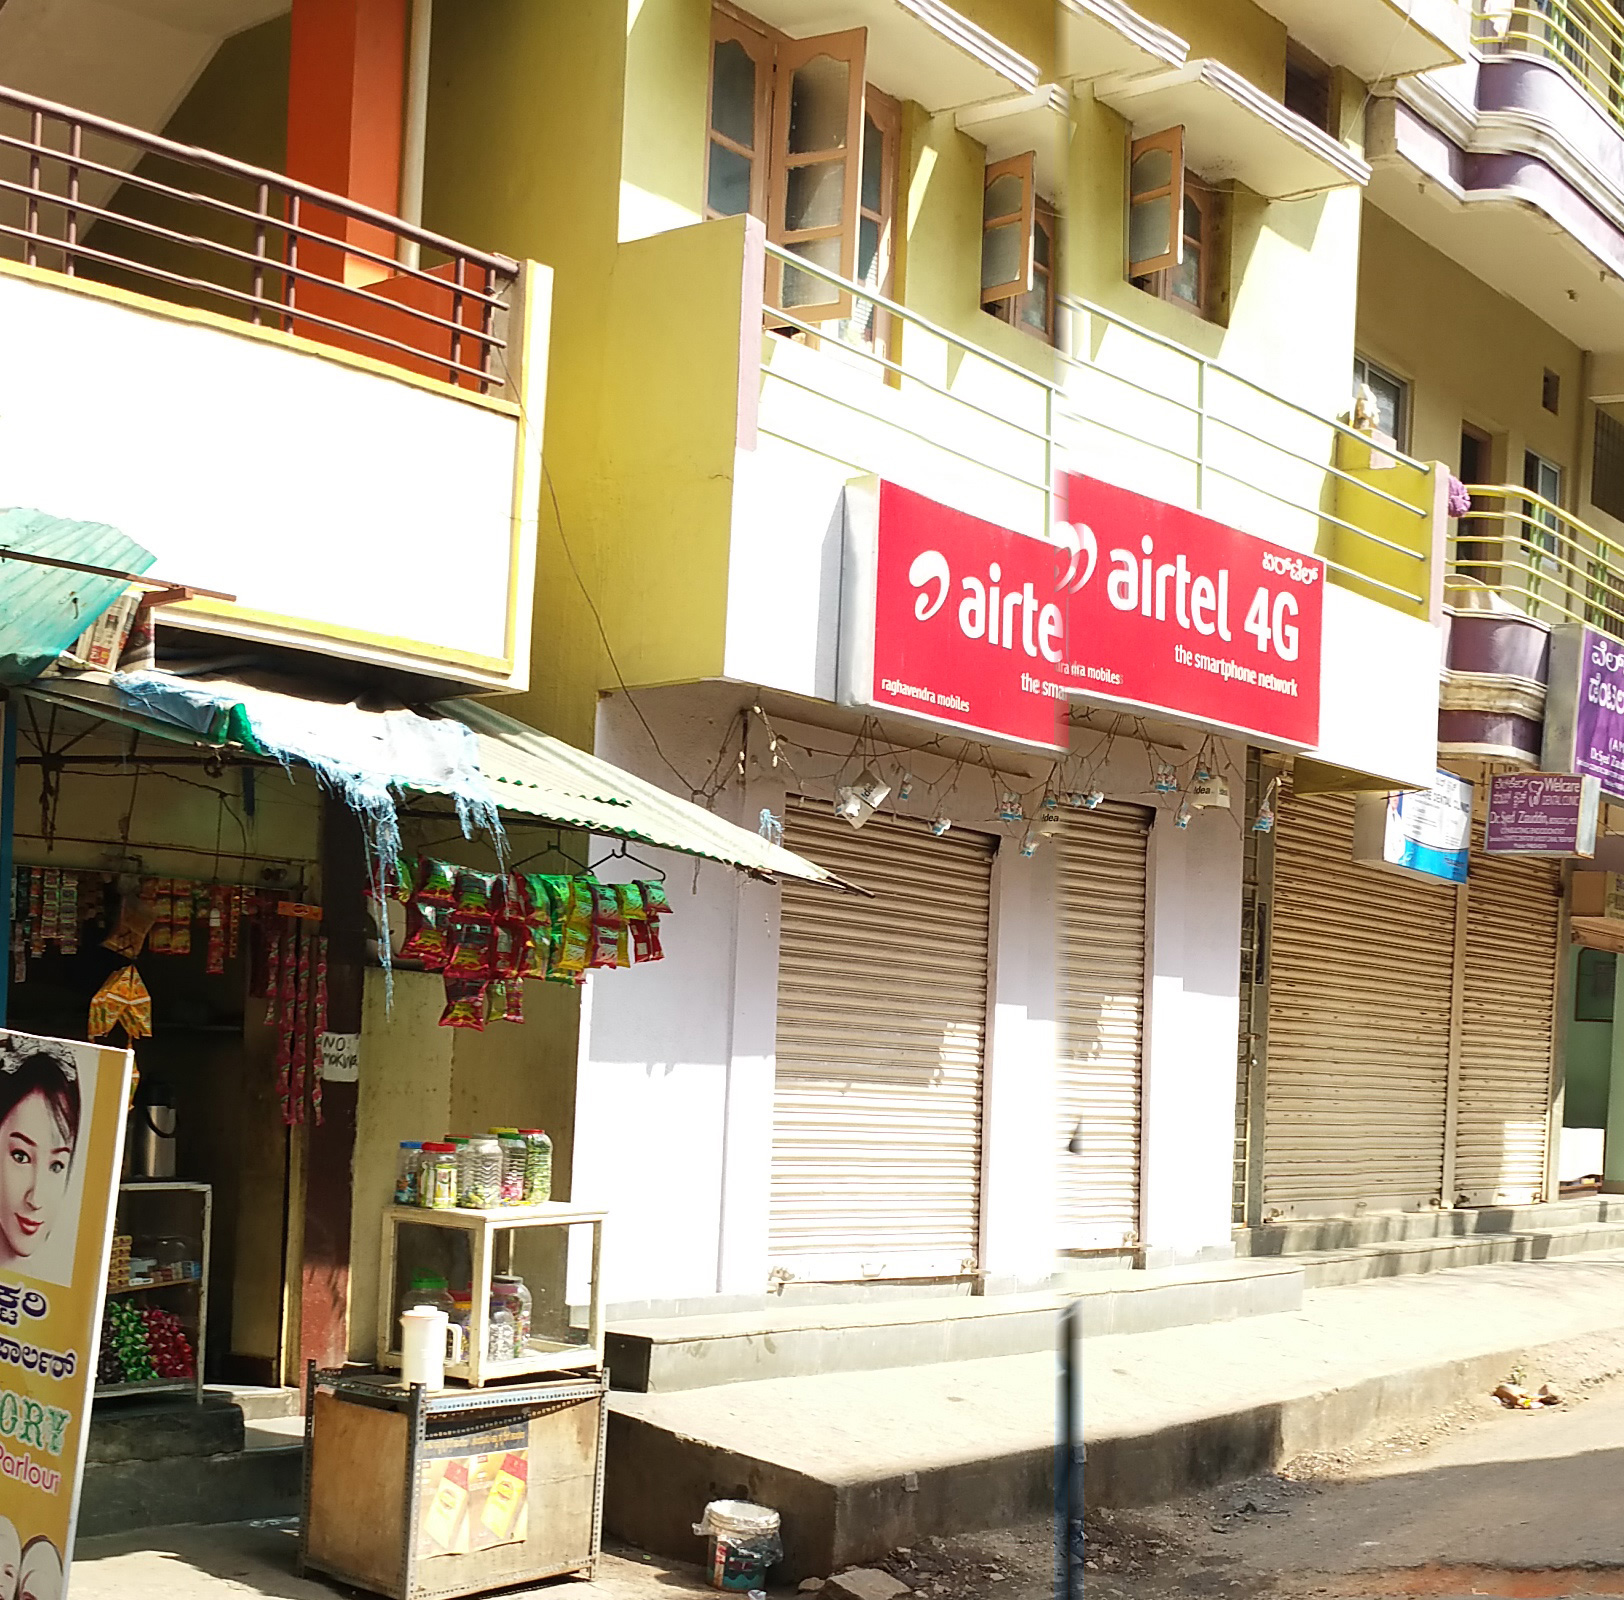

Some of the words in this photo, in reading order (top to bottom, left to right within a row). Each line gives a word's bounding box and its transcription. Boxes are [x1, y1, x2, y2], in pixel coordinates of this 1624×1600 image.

[1107, 534, 1232, 643] airtel
[1243, 584, 1300, 662] 4G
[1174, 643, 1193, 668] the
[1194, 652, 1256, 683] smartphone
[1258, 669, 1299, 698] network
[937, 691, 970, 713] mobiles
[1544, 777, 1580, 793] Welcare
